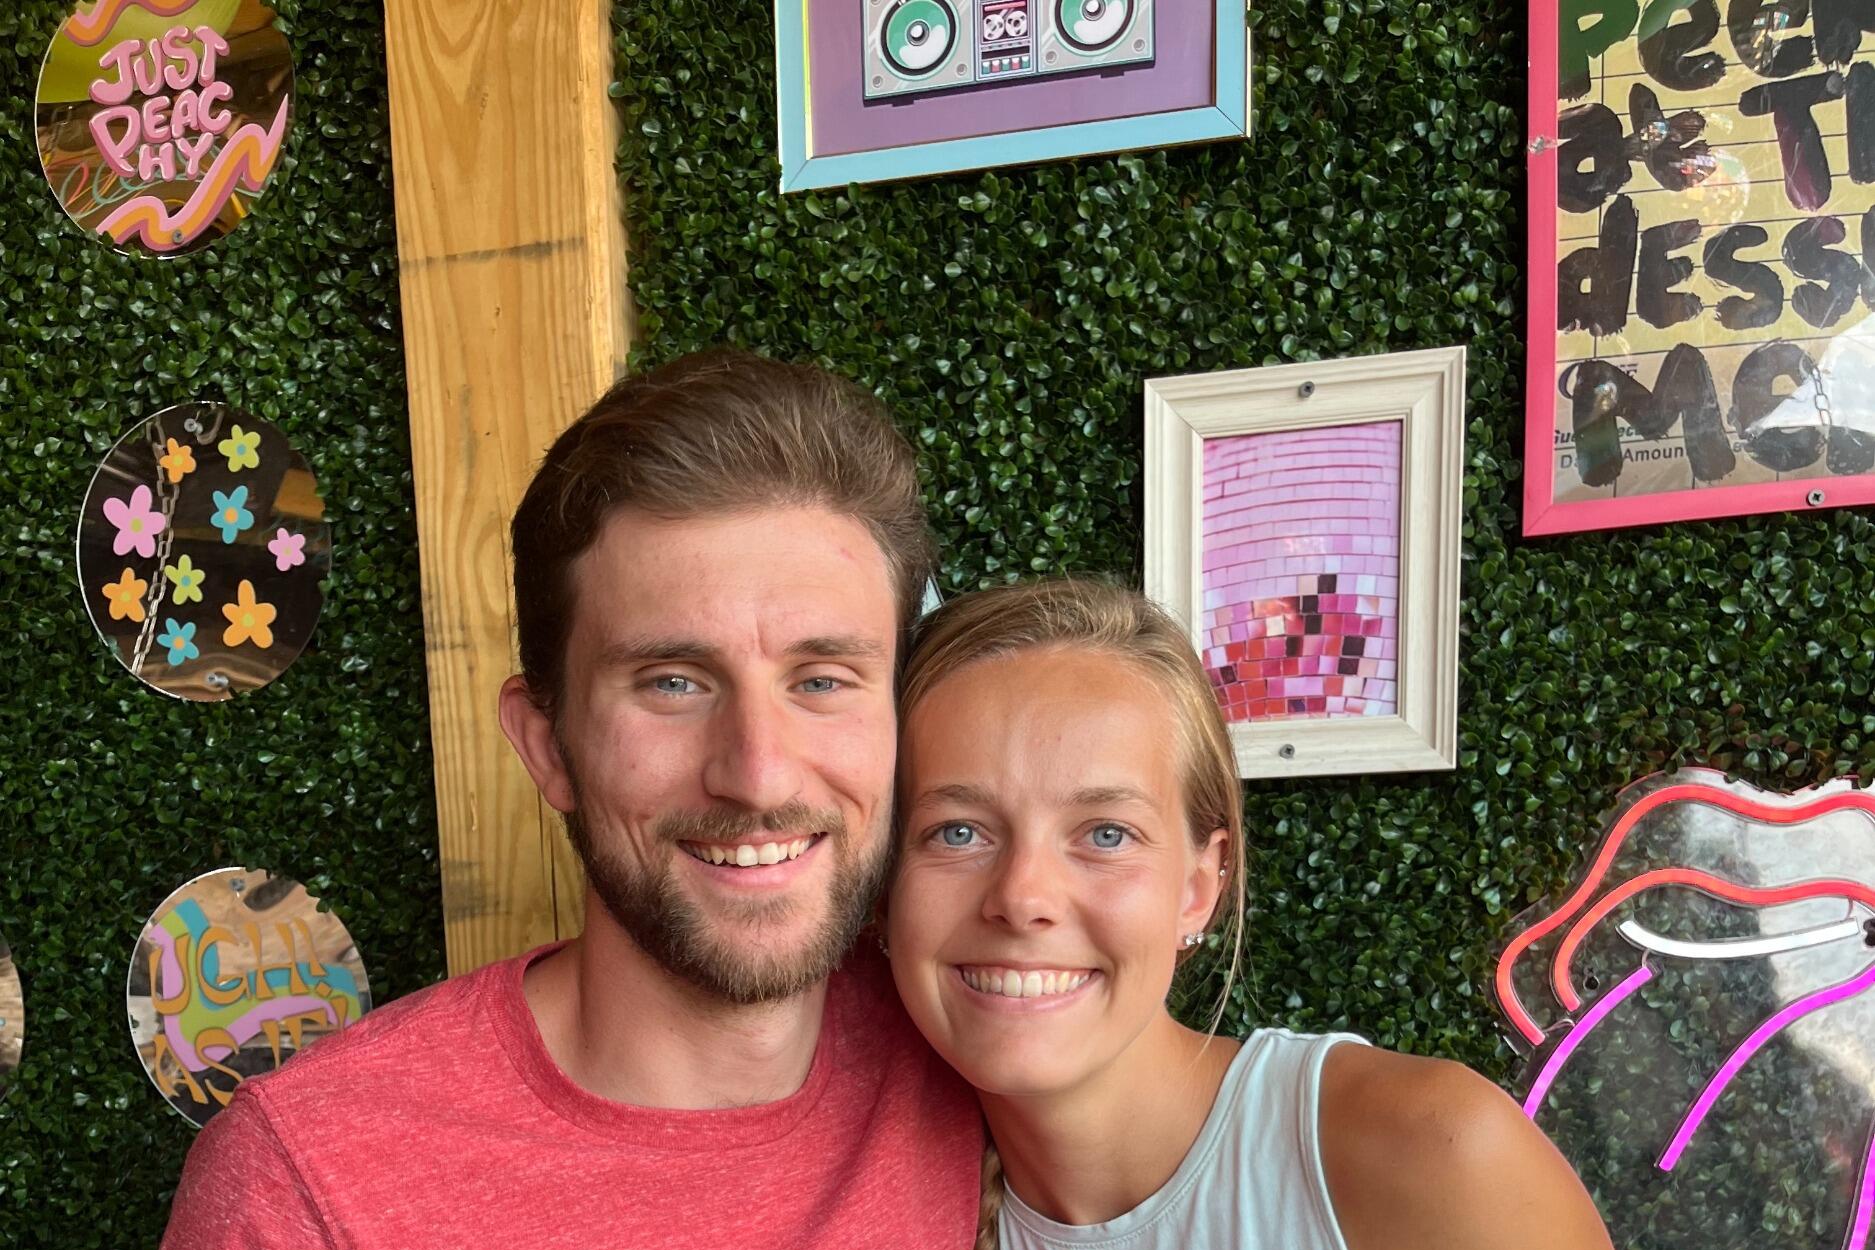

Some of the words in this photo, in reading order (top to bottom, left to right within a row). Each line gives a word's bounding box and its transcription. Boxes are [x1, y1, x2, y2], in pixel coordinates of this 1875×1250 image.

[89, 25, 230, 104] JUST
[89, 81, 234, 178] PEAC
[138, 132, 214, 182] HY
[1558, 194, 1875, 338] dESS
[1622, 445, 1687, 463] Amoun
[149, 917, 334, 1016] UGH!
